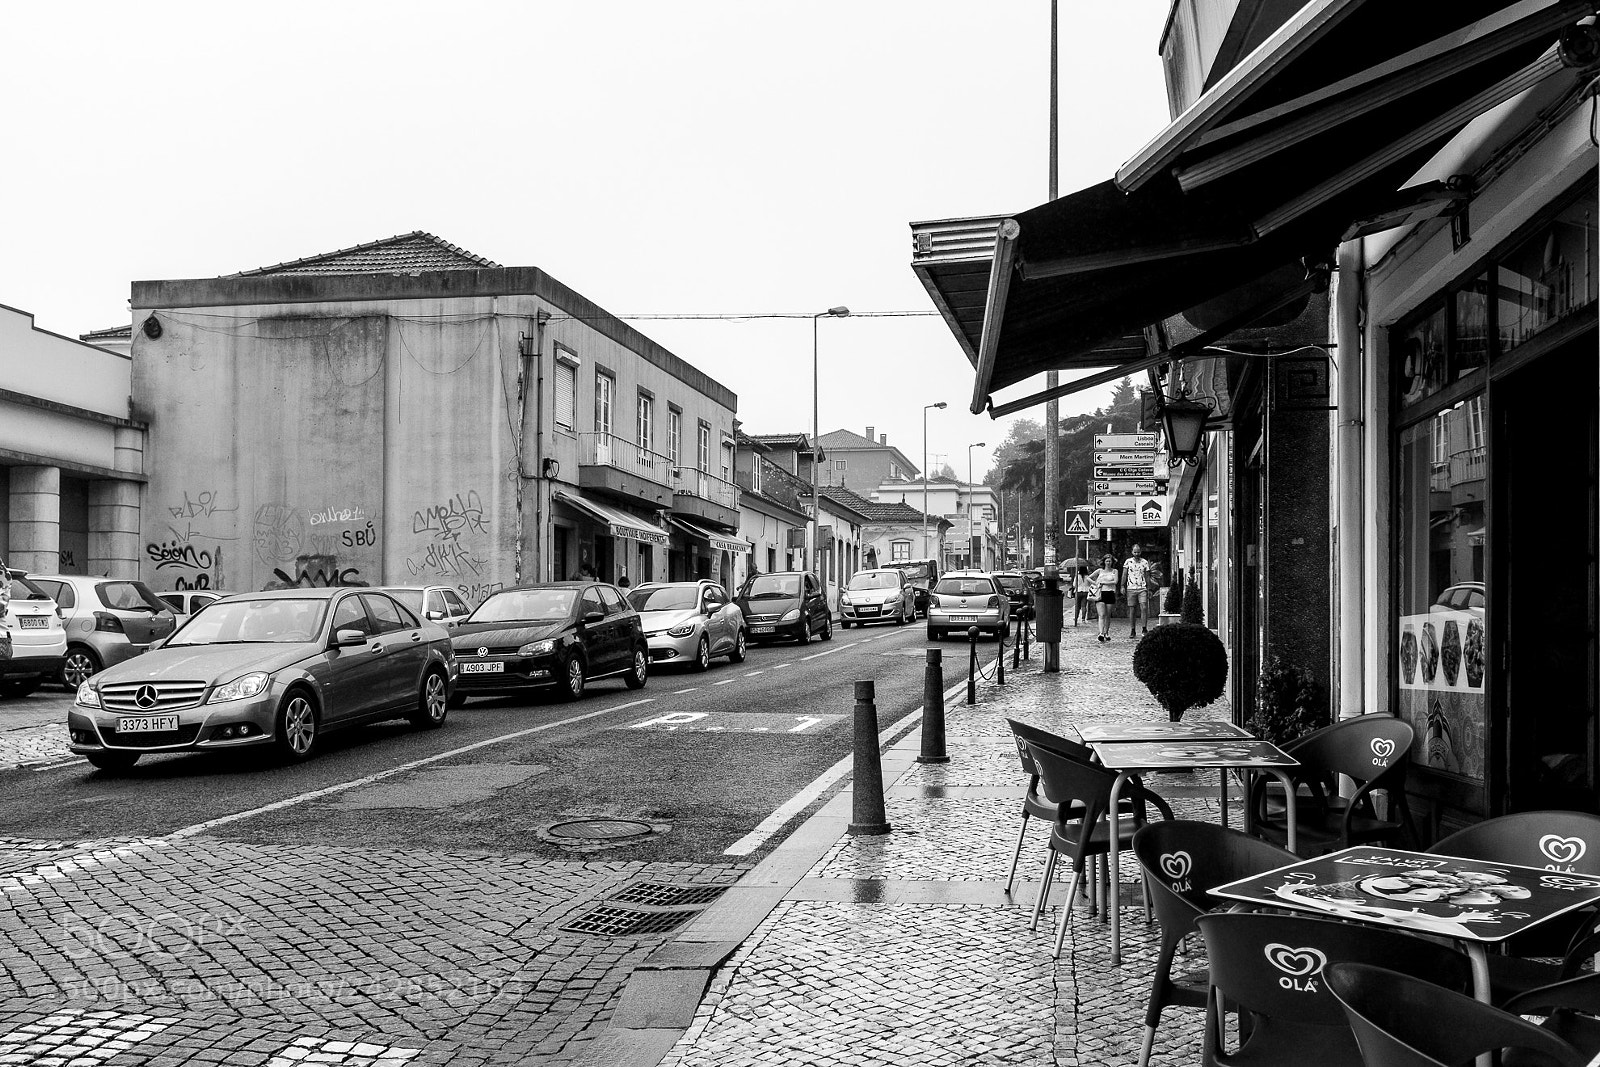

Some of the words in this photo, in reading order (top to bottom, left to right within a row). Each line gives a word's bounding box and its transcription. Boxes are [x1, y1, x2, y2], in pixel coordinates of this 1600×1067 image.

[615, 525, 639, 539] BOUTIQUE
[466, 664, 485, 672] 4903
[487, 663, 501, 672] JPF
[122, 719, 149, 730] 3373
[151, 717, 175, 729] HFY
[1372, 757, 1388, 768] OLÁ
[1172, 877, 1192, 893] OLÁ
[1279, 976, 1318, 993] OLÁ
